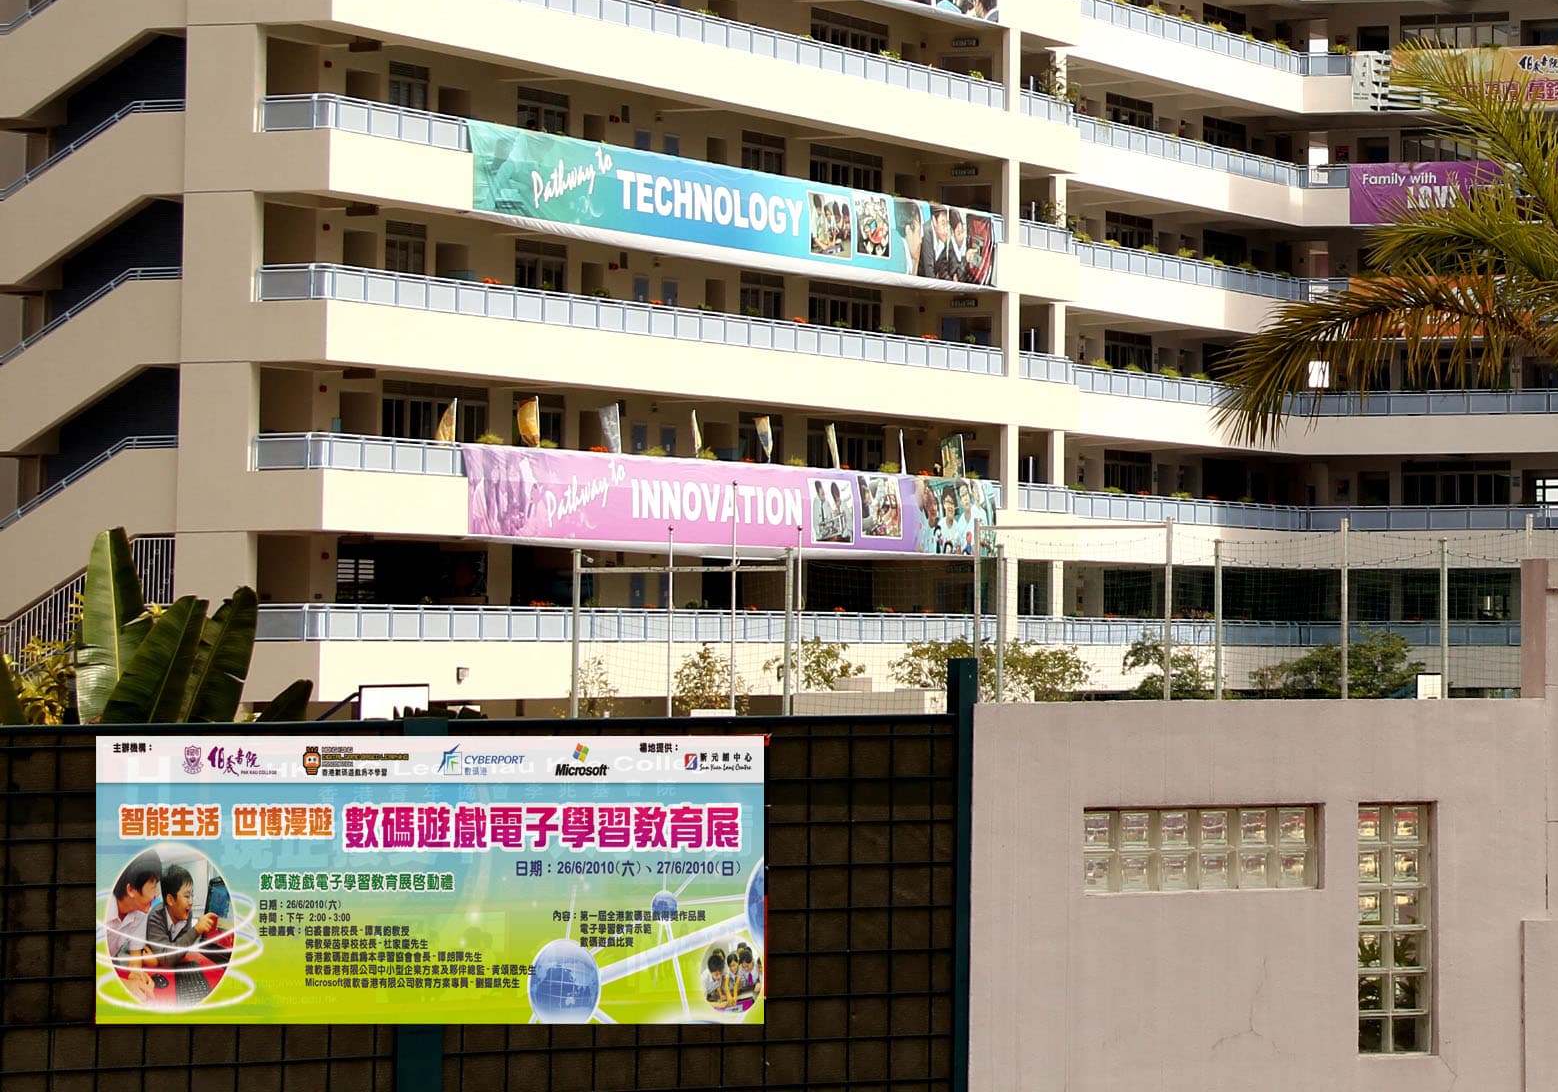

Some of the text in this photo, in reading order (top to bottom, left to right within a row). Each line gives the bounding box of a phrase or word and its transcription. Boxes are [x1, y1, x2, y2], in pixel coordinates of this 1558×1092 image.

[532, 147, 613, 208] Pathway to
[1362, 172, 1437, 186] Family with
[616, 170, 804, 236] TECHNOLOGY
[547, 461, 627, 526] Pathway to
[631, 479, 803, 527] INNOVATION
[464, 755, 525, 765] CYBERPORT
[555, 763, 607, 777] Microsoft
[121, 806, 739, 849] 智能生活 世博漫遊 數碼遊戲電子學習教育展
